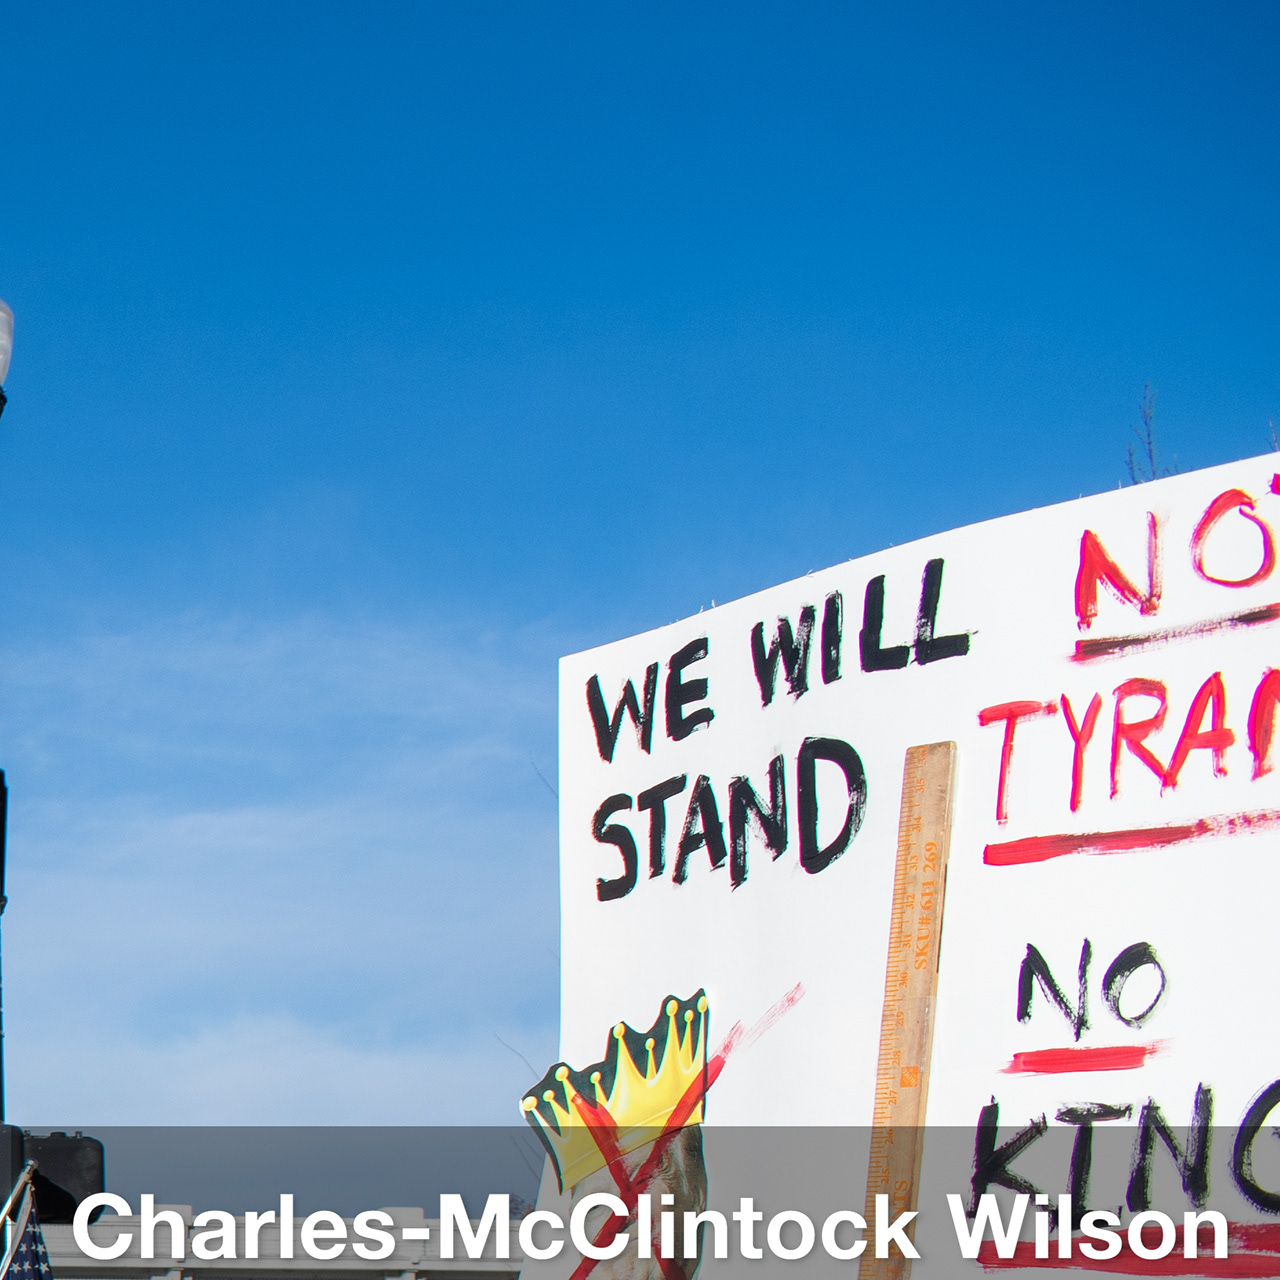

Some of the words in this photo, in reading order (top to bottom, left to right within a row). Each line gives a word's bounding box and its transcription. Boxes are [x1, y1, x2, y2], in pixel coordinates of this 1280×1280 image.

[586, 637, 714, 763] WE
[751, 557, 974, 707] WILL
[1076, 472, 1280, 628] NO
[592, 736, 867, 902] STAND
[923, 841, 938, 874] 269
[920, 880, 936, 911] 611
[914, 915, 932, 971] SKU#
[1016, 938, 1170, 1043] NO
